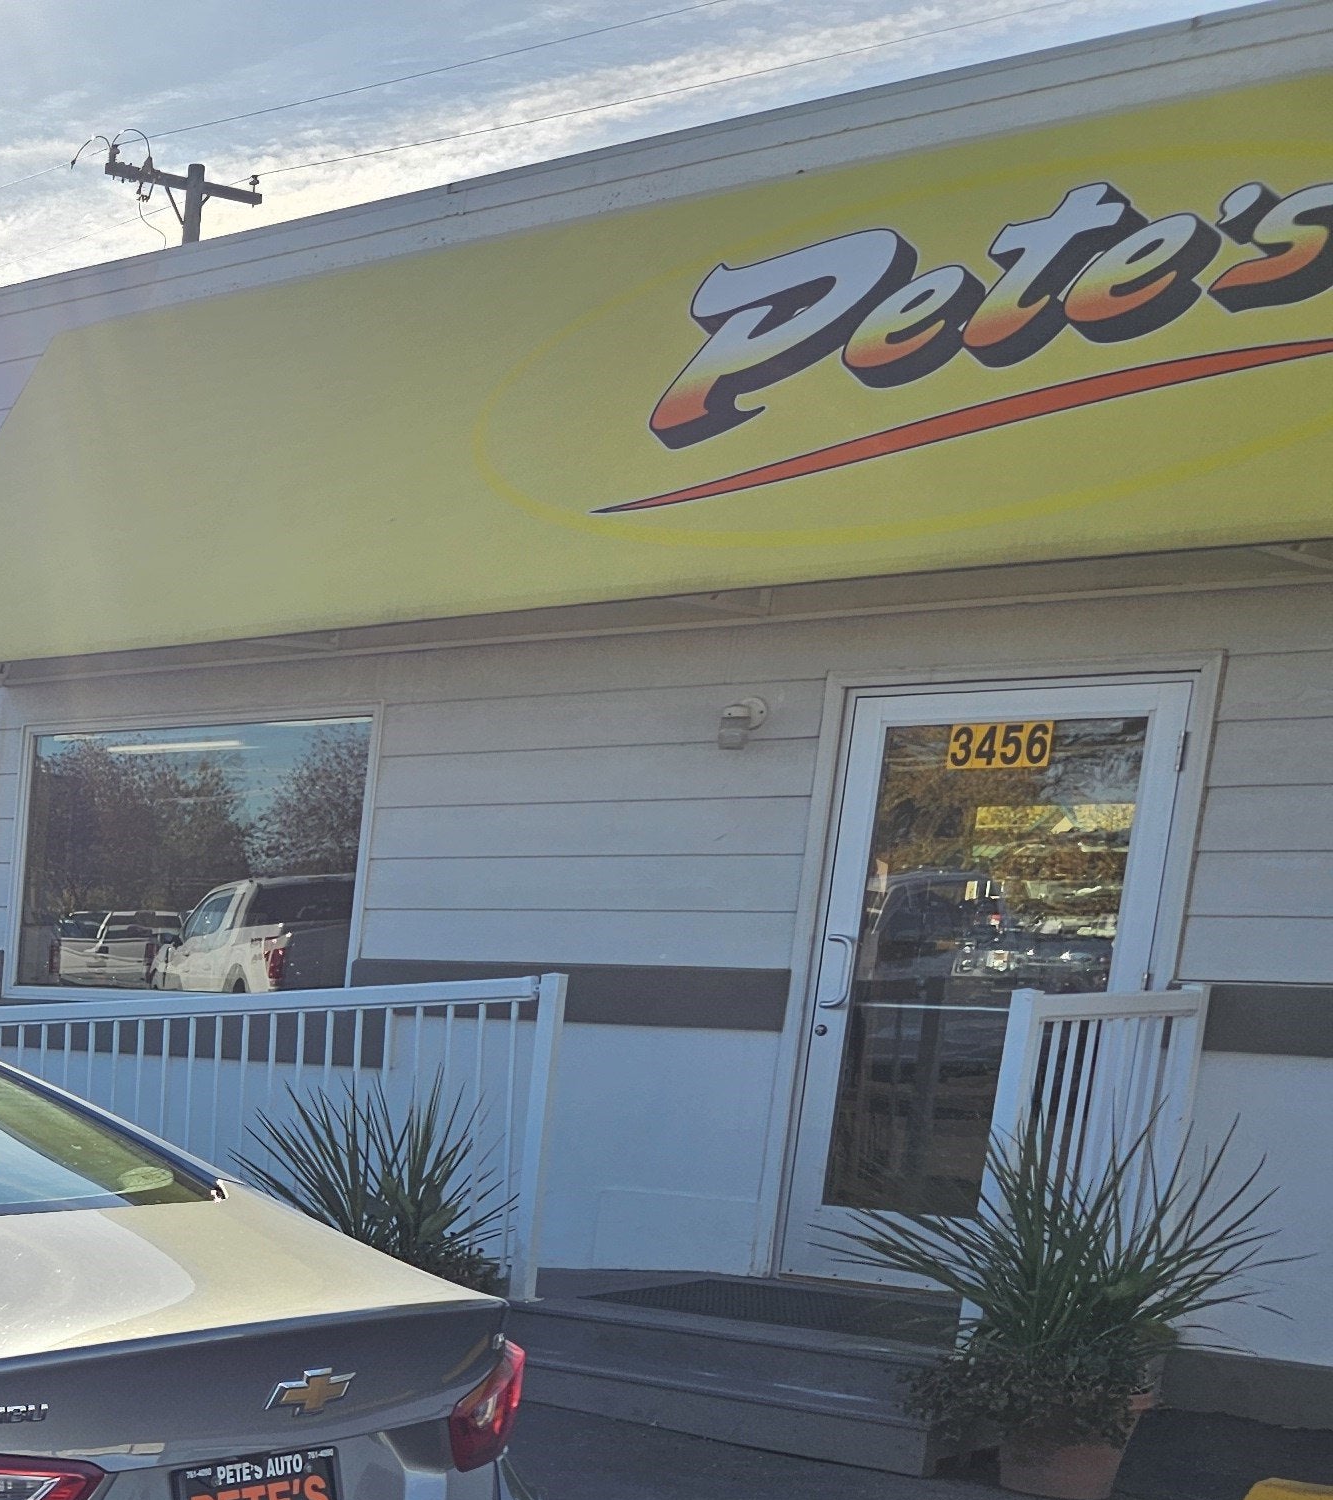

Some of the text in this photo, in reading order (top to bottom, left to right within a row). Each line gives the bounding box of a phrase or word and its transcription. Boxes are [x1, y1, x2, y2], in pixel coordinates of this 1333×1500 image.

[649, 181, 1333, 446] Pete's
[950, 724, 1049, 766] 3456
[266, 1453, 303, 1478] AUTO
